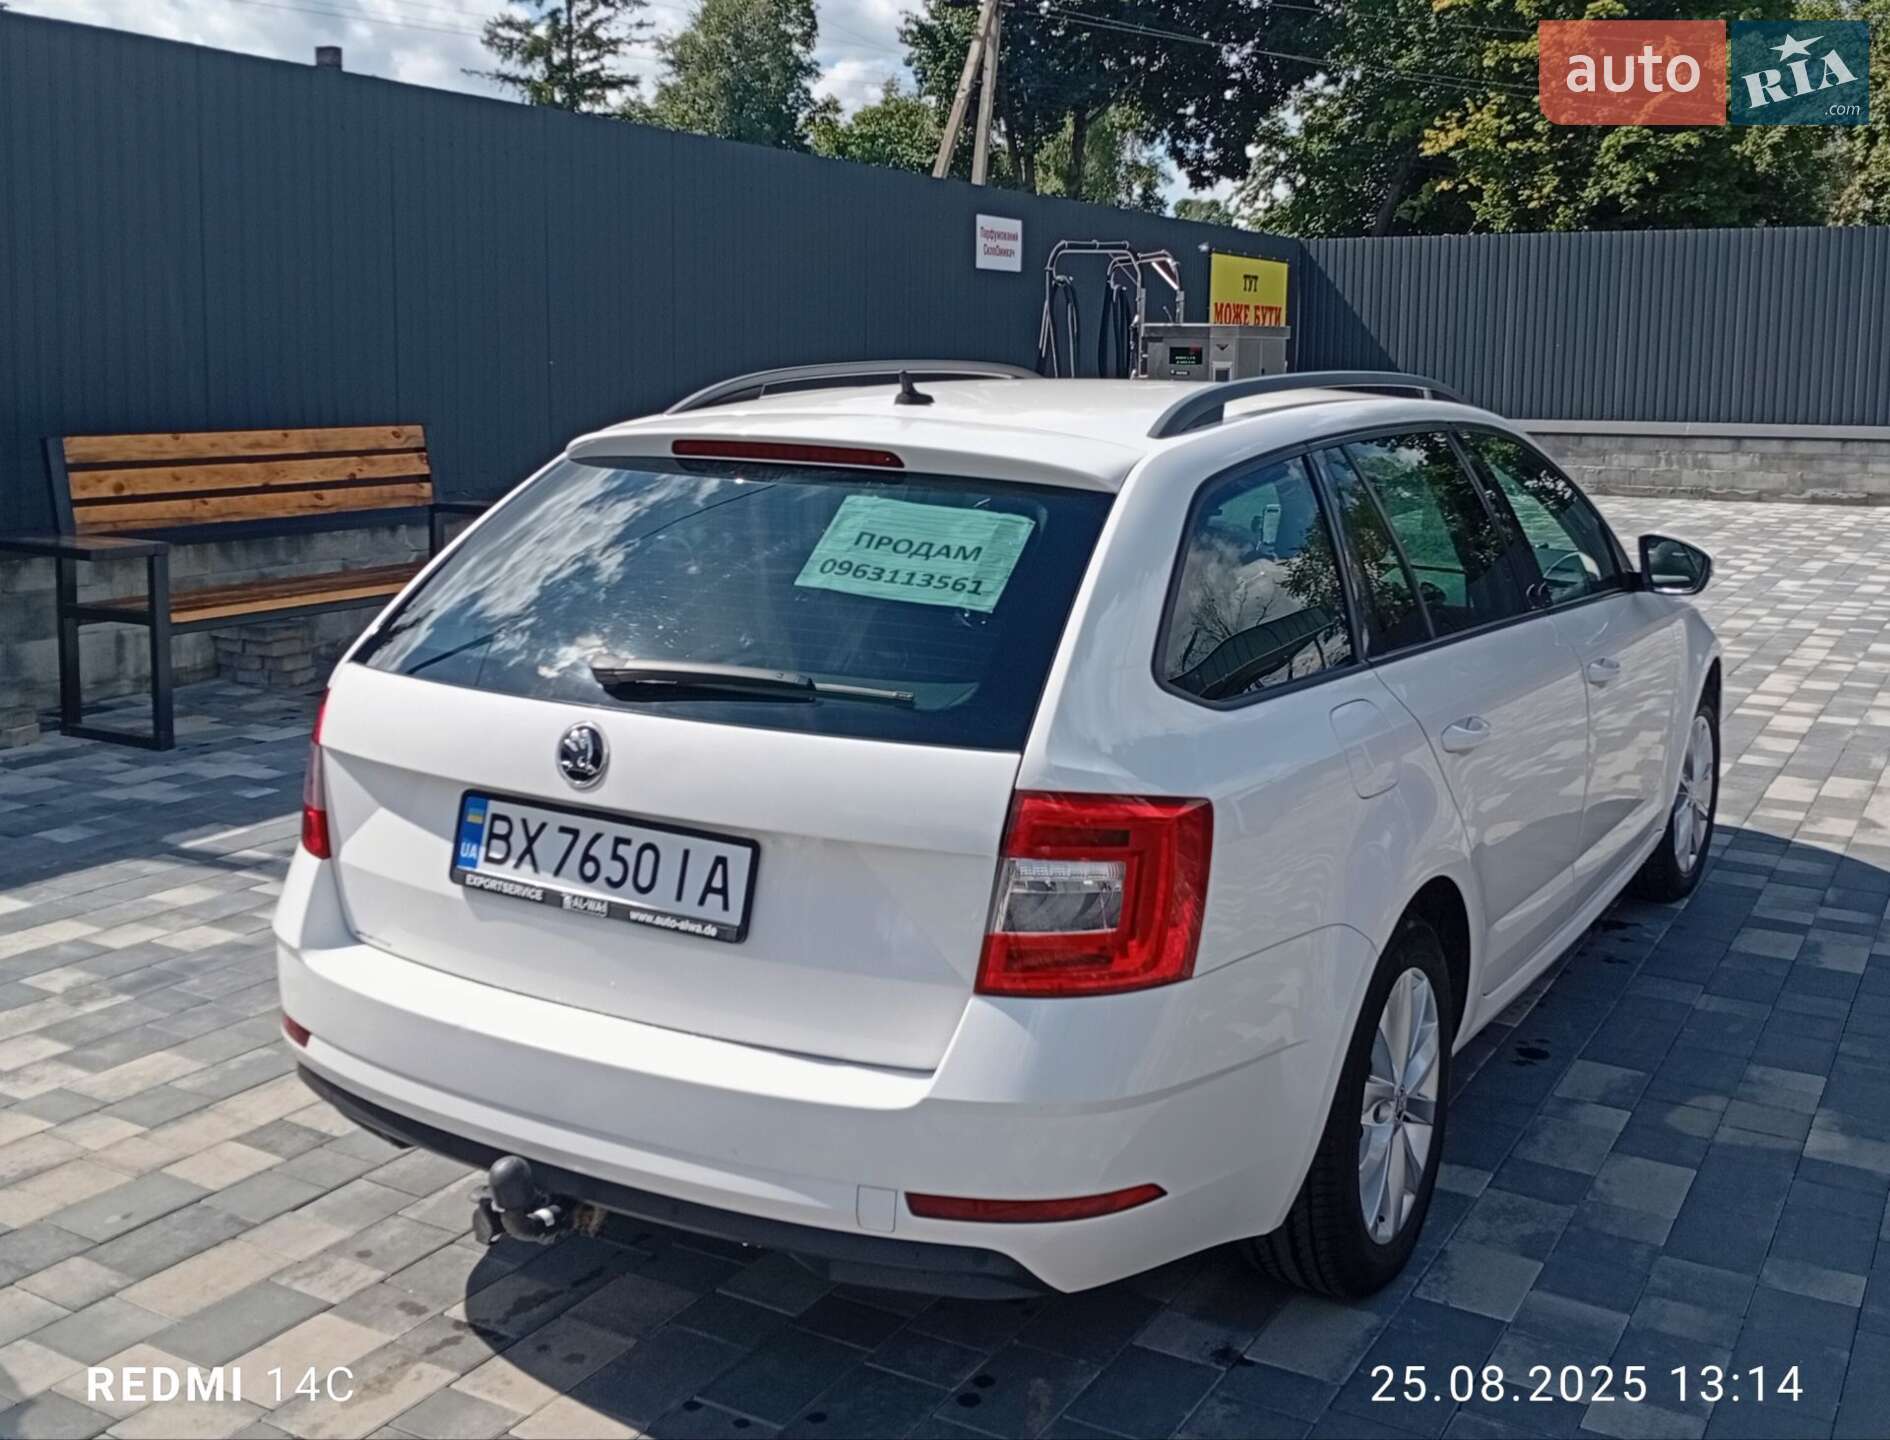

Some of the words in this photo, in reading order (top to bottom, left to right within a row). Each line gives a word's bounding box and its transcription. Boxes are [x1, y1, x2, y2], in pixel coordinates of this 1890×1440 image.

[1243, 274, 1259, 292] ТУТ
[1214, 302, 1250, 326] МОЖЕ
[1254, 304, 1282, 327] БУТИ
[853, 530, 983, 562] ПРОДАМ
[819, 557, 983, 596] 0963113561
[460, 842, 478, 860] UA
[553, 825, 662, 895] 7650
[464, 873, 545, 901] EXPORTSERVICE
